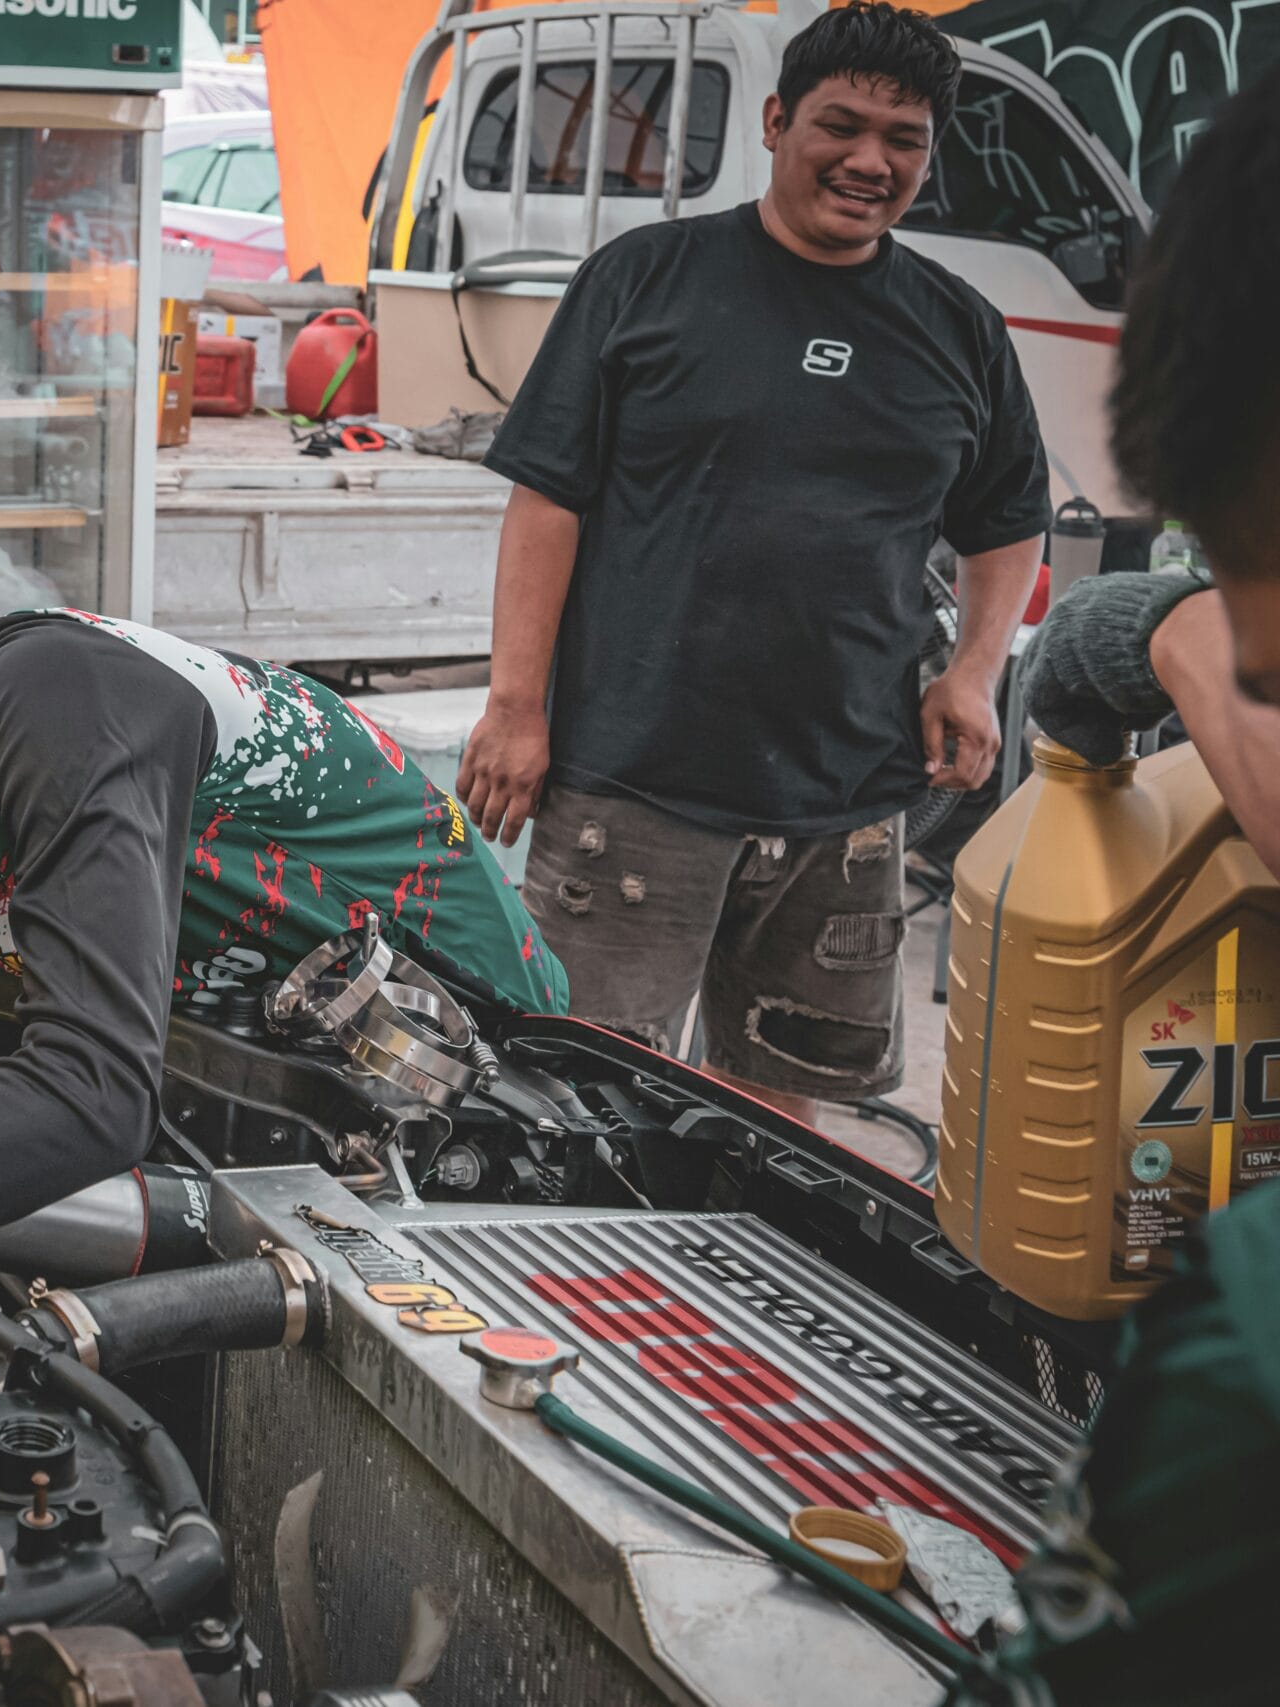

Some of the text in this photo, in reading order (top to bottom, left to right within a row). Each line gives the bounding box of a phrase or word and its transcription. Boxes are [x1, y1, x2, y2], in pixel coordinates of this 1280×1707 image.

[159, 332, 185, 373] IC
[1151, 1021, 1177, 1041] SK
[1246, 1151, 1280, 1166] 15W-
[183, 1178, 207, 1233] SUPER
[672, 1241, 903, 1382] COOLER
